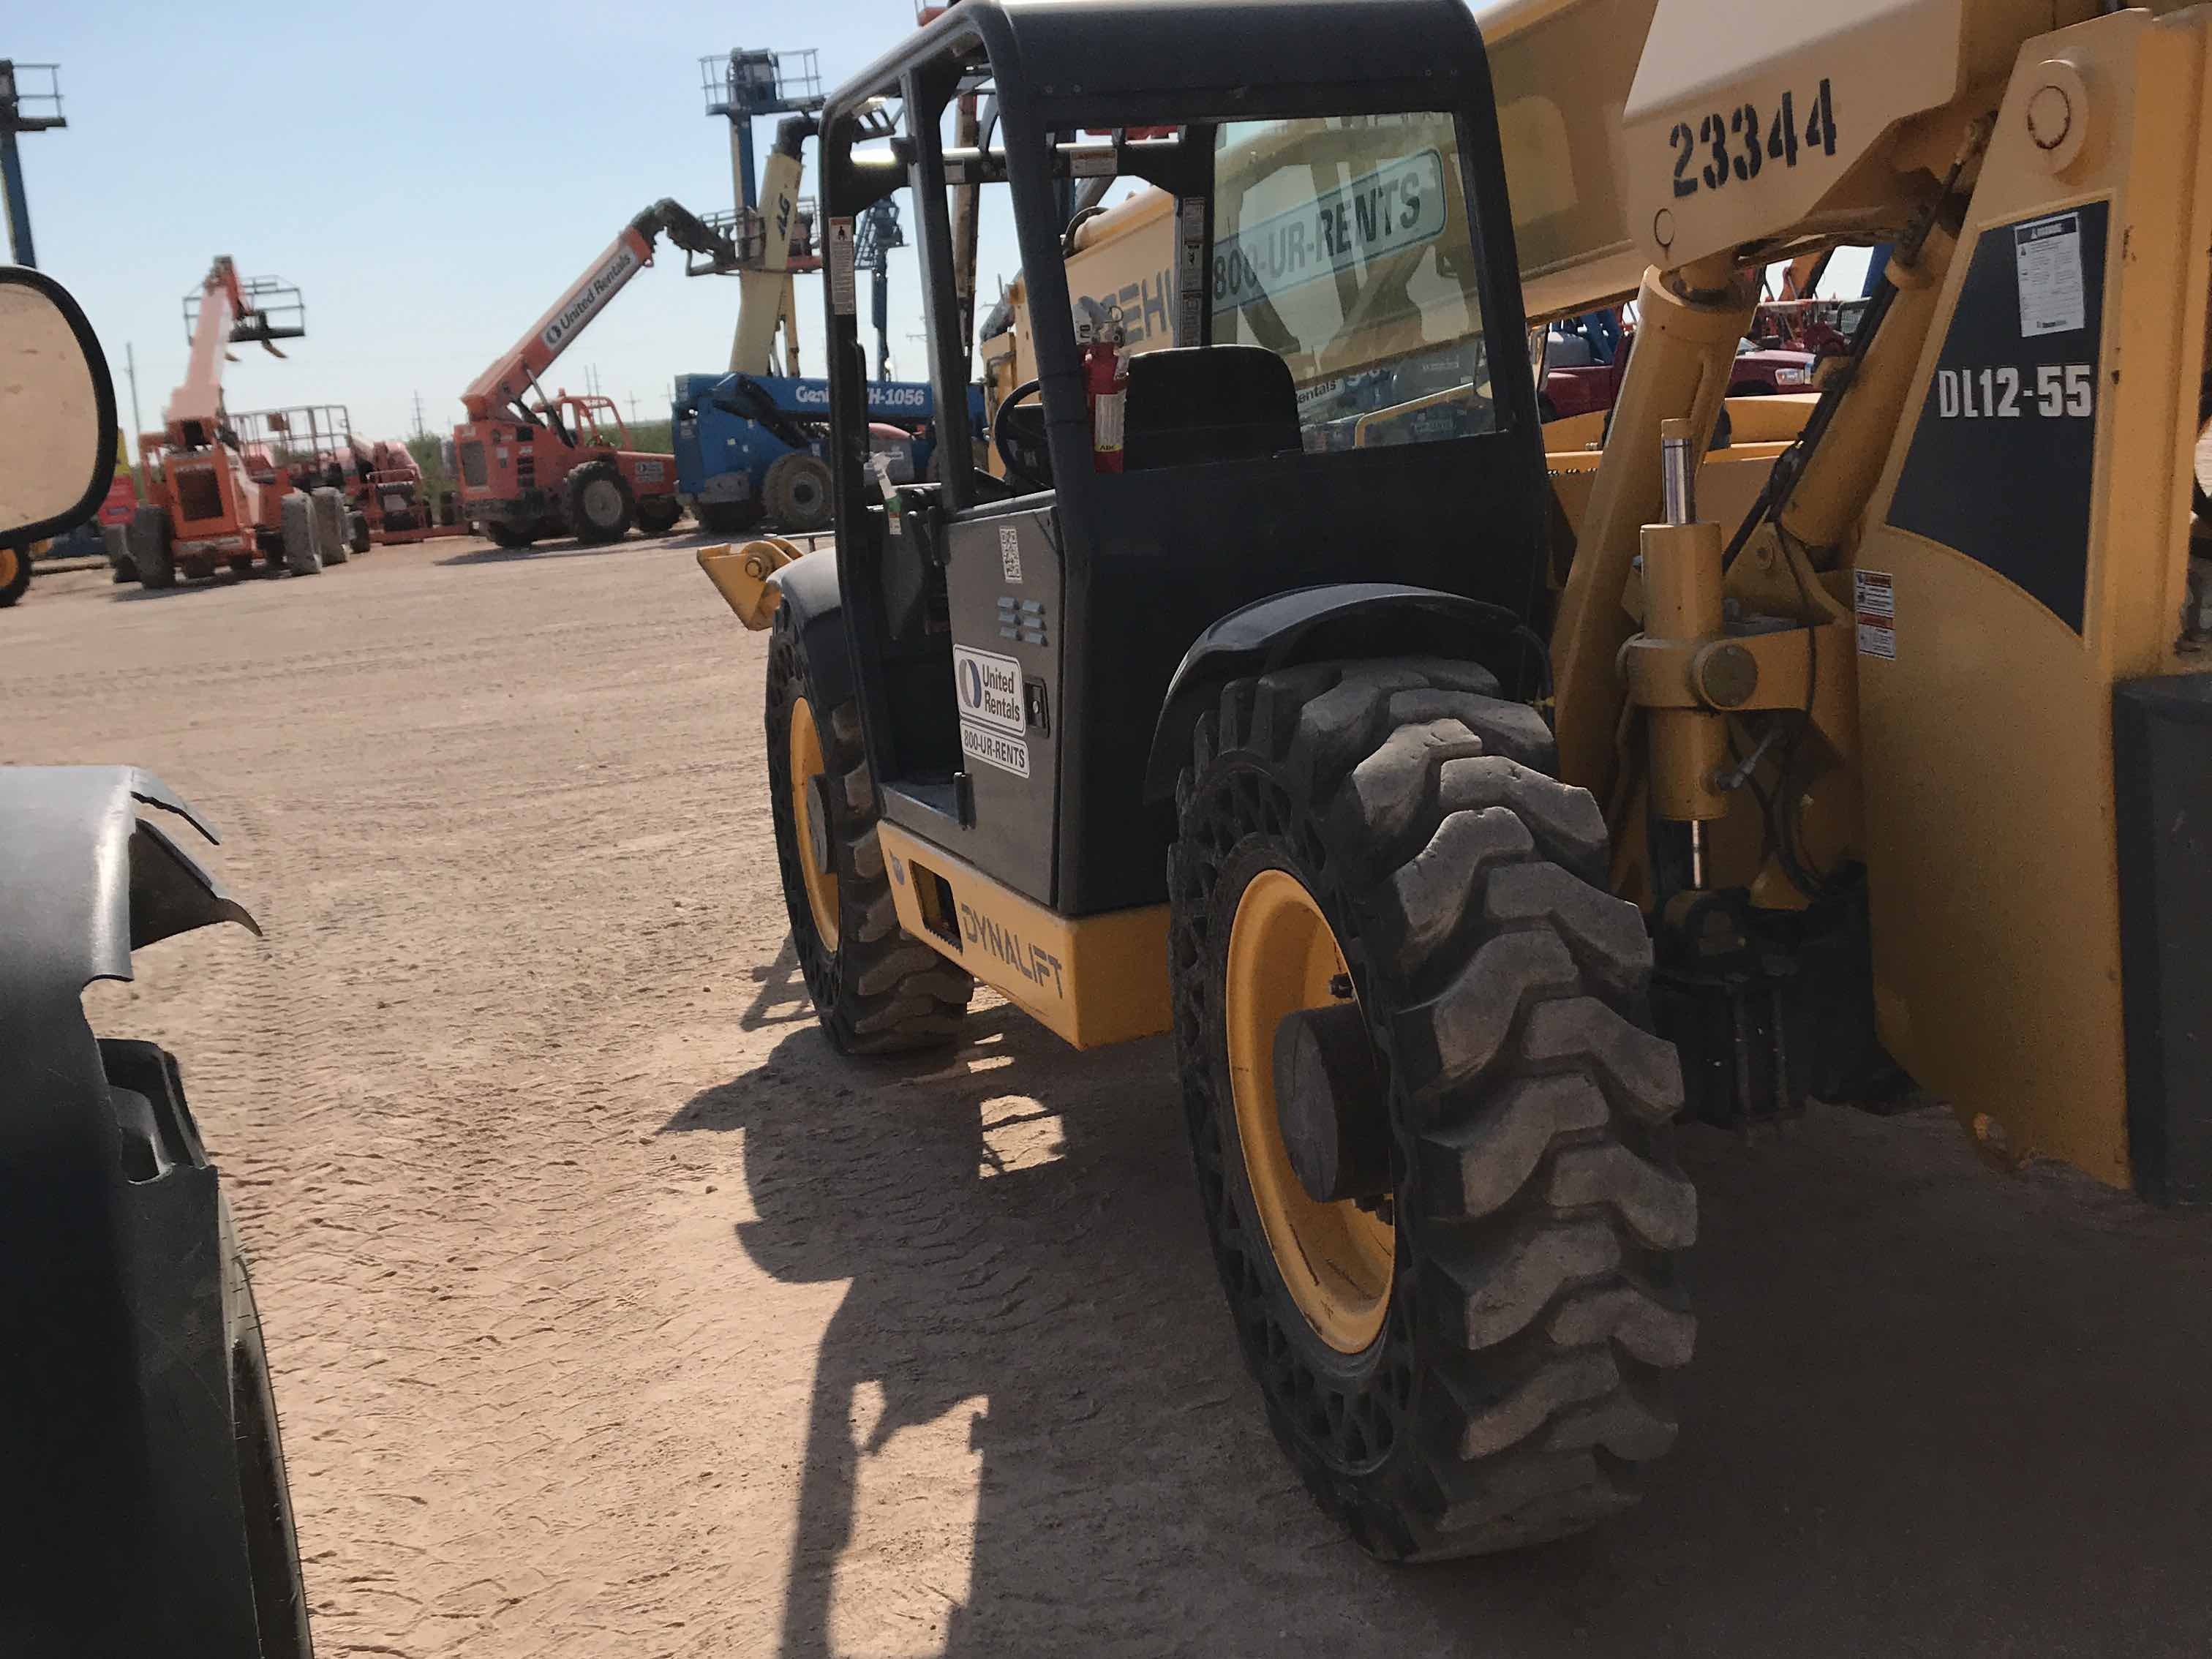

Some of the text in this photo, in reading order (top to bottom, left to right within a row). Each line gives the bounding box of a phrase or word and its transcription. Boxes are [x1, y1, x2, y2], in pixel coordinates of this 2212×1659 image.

[1669, 78, 1837, 198] 23344
[1214, 172, 1421, 301] 800-UR-RENTS
[560, 254, 631, 329] United Rentals
[796, 385, 830, 404] Geni
[1295, 380, 1337, 405] entals
[1938, 364, 2091, 417] DL12-55
[982, 663, 1015, 694] United
[985, 690, 1020, 722] Rentals
[964, 729, 1025, 769] 800-UR-RENTS
[961, 903, 1063, 999] DYNALIFT
